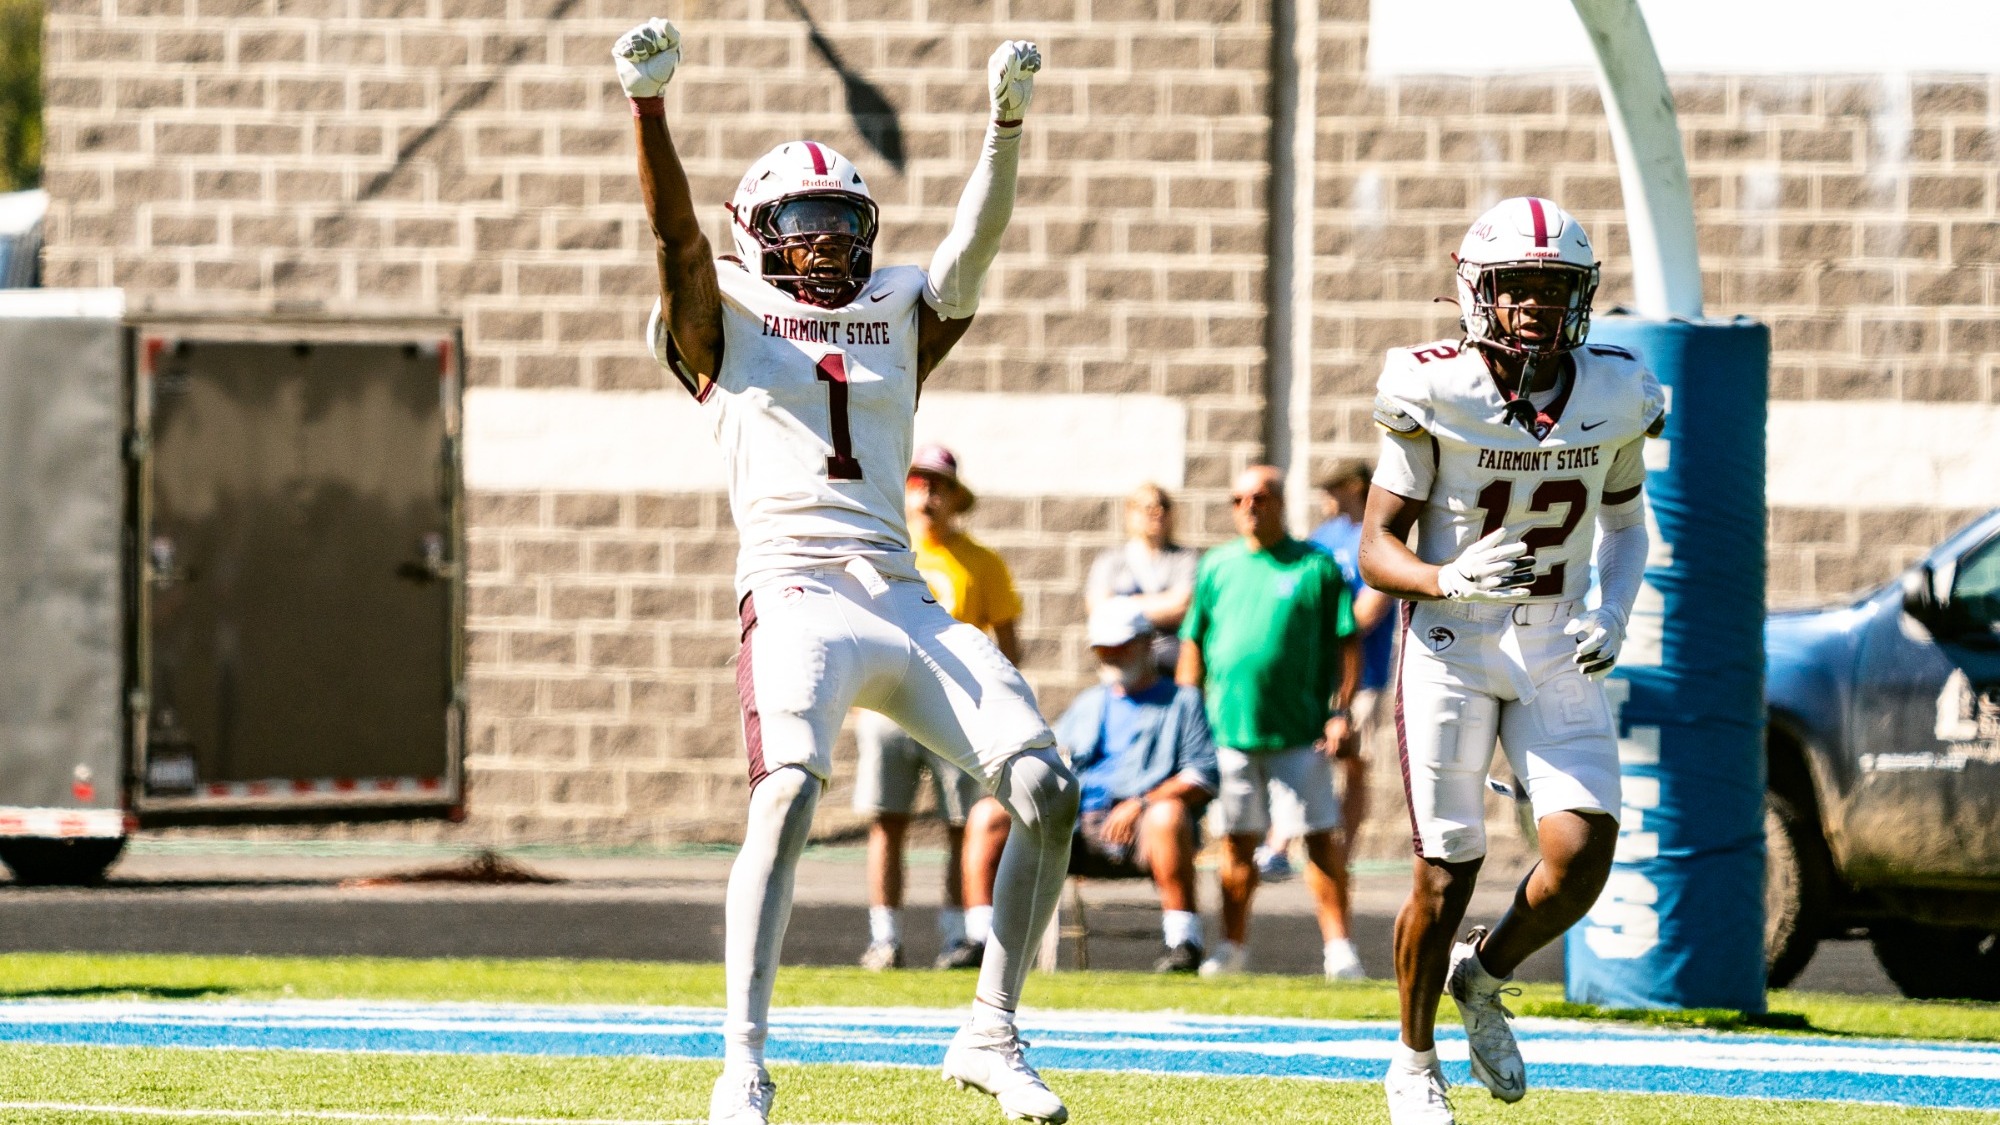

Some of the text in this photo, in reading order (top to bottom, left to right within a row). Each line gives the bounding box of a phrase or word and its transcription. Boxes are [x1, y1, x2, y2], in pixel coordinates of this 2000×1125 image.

[802, 179, 842, 188] Riddell
[762, 314, 890, 345] FAIRMONT STATE
[1411, 345, 1459, 364] 2
[815, 352, 865, 483] 1
[1477, 445, 1600, 472] FAIRMONT STATE
[1474, 477, 1589, 598] 12
